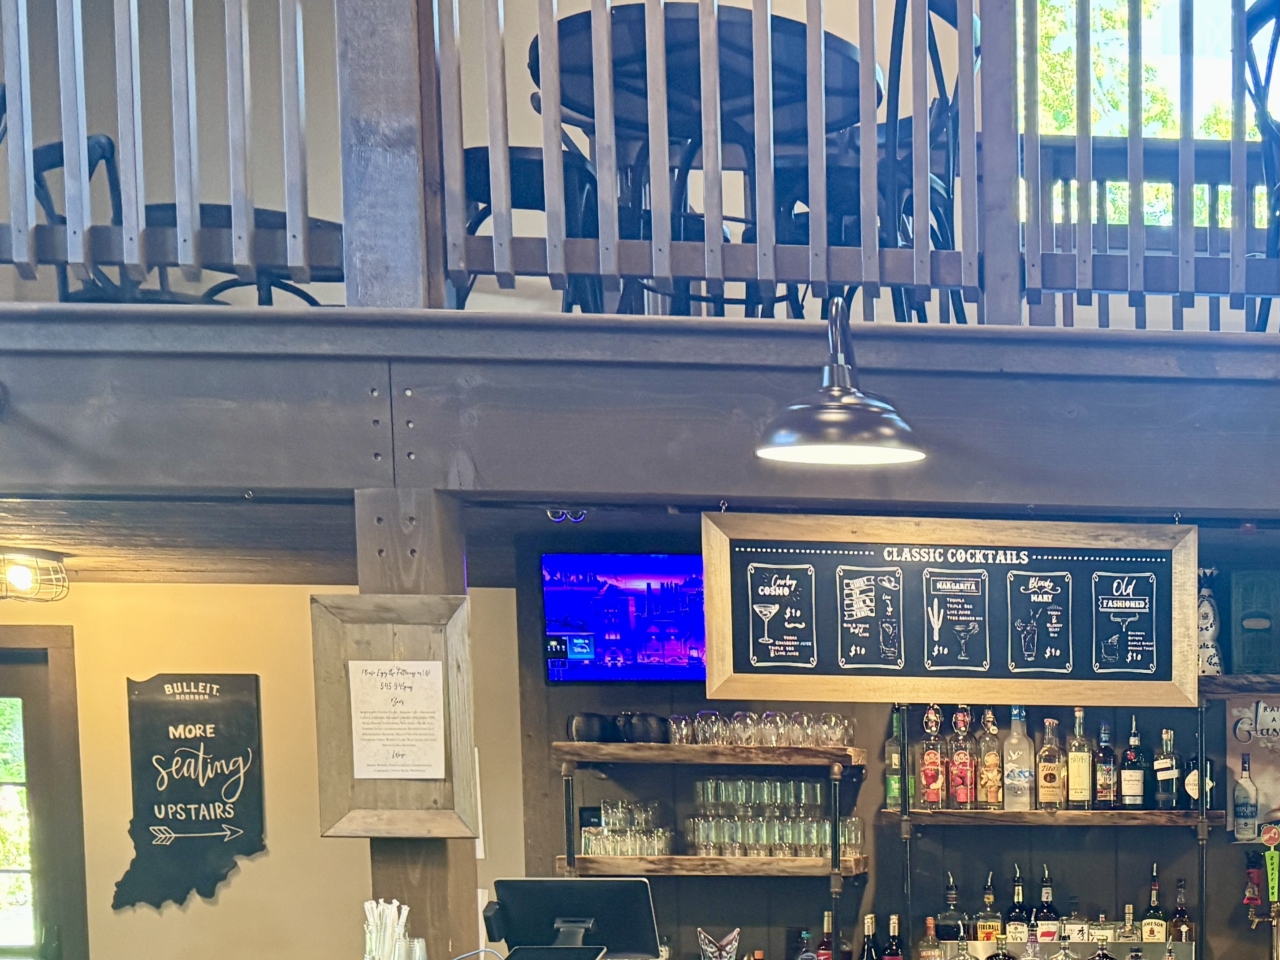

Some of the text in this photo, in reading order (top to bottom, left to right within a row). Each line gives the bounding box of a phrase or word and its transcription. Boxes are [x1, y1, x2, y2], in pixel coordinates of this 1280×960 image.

[883, 547, 1029, 564] CLASSIC COCKTAILS
[936, 582, 976, 590] MARGARITA
[1028, 577, 1054, 589] Bloody
[1113, 577, 1137, 597] Old
[758, 586, 790, 596] COSMO
[1031, 594, 1053, 603] MARY
[1103, 600, 1145, 608] FASHIONED
[784, 607, 801, 619] $10
[849, 645, 866, 657] $10
[932, 645, 949, 657] $10
[1044, 647, 1061, 659] $10
[1125, 652, 1142, 664] $10
[168, 724, 215, 739] MORE
[154, 802, 235, 820] UPSTAIRS
[1044, 892, 1050, 900] 7
[978, 924, 1000, 932] FIREBALL
